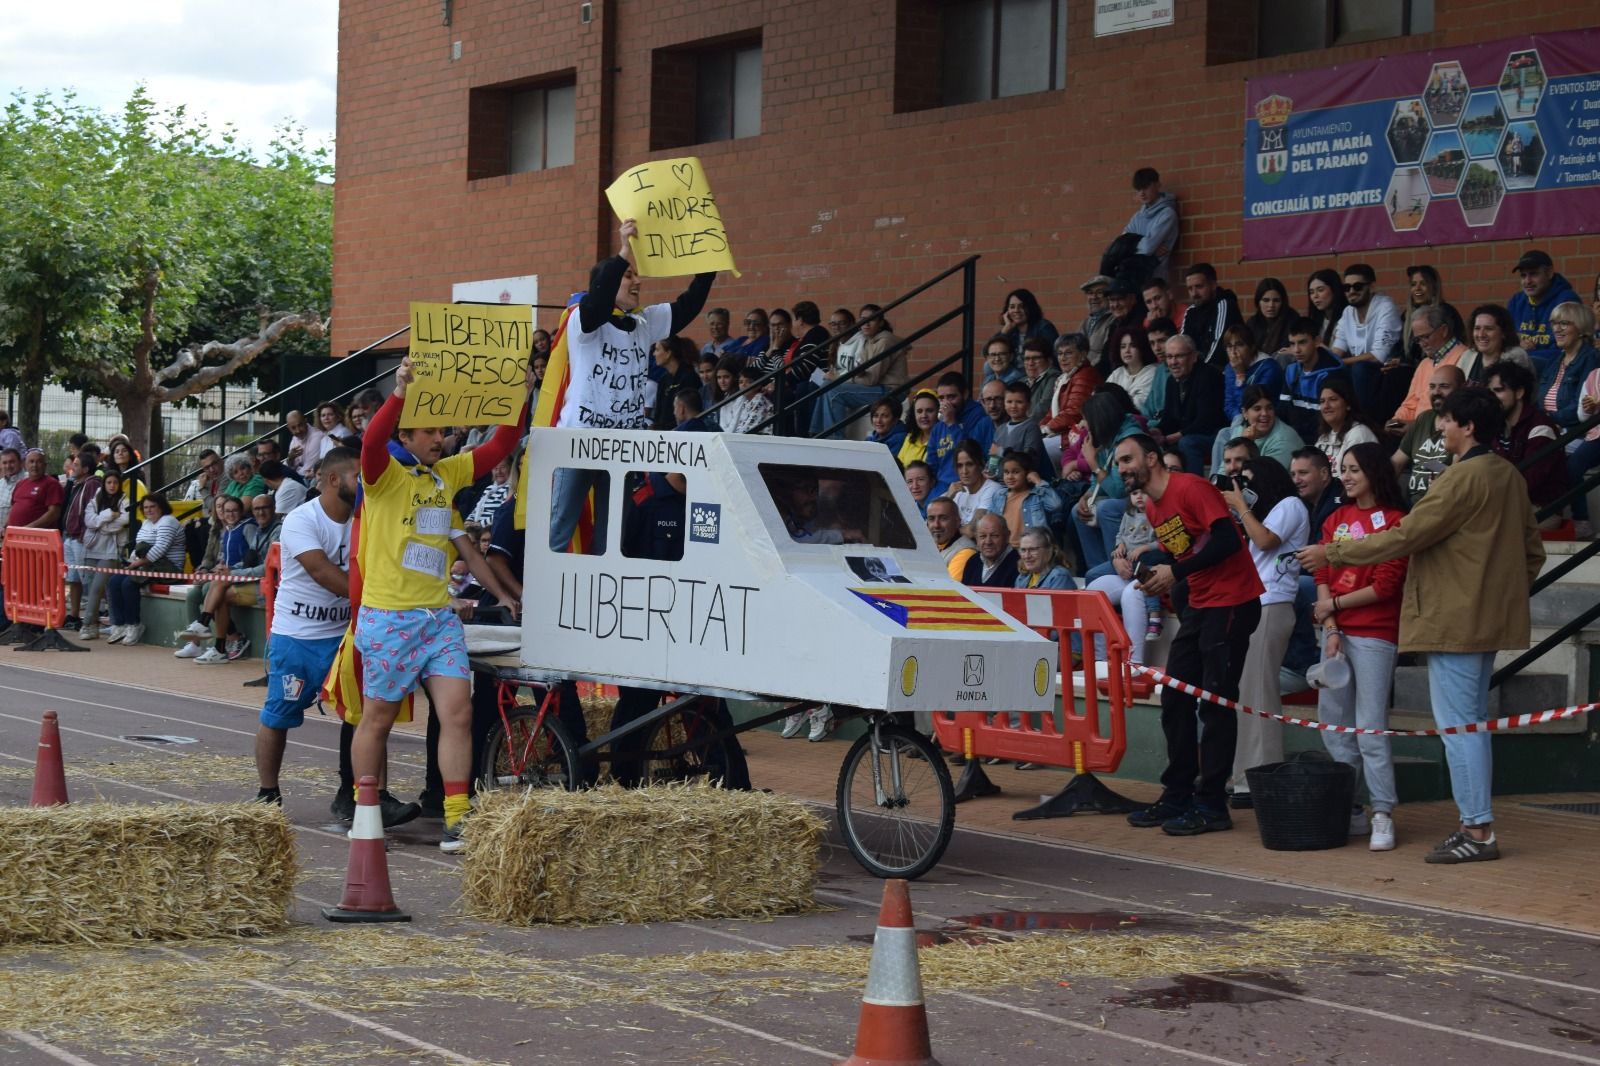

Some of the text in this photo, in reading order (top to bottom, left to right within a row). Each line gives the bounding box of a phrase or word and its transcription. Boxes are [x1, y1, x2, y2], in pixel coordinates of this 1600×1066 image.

[1549, 82, 1585, 95] EVENTOS
[1292, 121, 1352, 139] AYUNTAMIENTO
[1291, 131, 1373, 157] SANTA MARÍA
[1291, 152, 1368, 173] DEL PÁRAMO
[628, 168, 655, 193] I
[1251, 188, 1382, 216] CONCEJALÍA DE DEPORTES
[439, 350, 529, 387] PRESOS
[570, 435, 708, 468] INDEPENDÈNCIA
[558, 572, 760, 655] LLIBERTAT
[956, 690, 987, 701] HONDA
